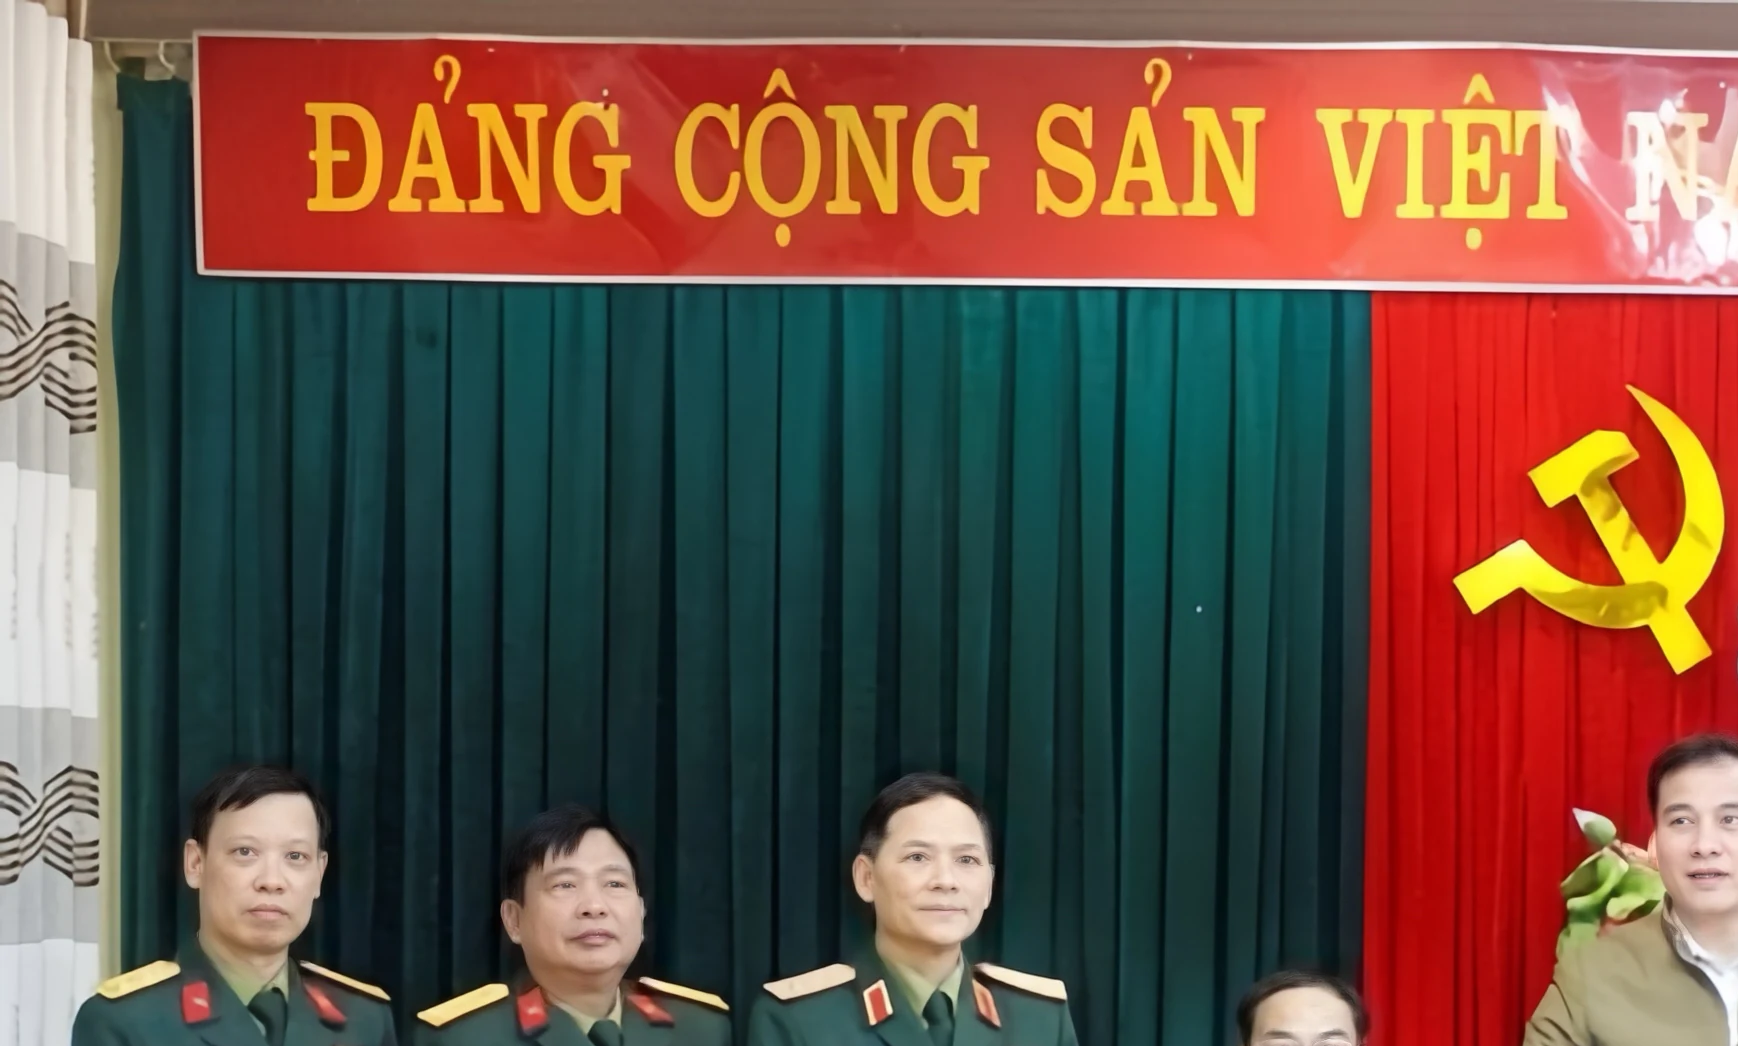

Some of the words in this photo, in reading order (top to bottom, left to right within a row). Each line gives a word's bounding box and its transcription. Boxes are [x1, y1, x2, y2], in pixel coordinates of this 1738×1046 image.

[305, 55, 632, 217] ĐẢNG
[673, 68, 991, 248] CỘNG
[1036, 58, 1266, 217] SẢN
[1315, 73, 1569, 251] VIỆT
